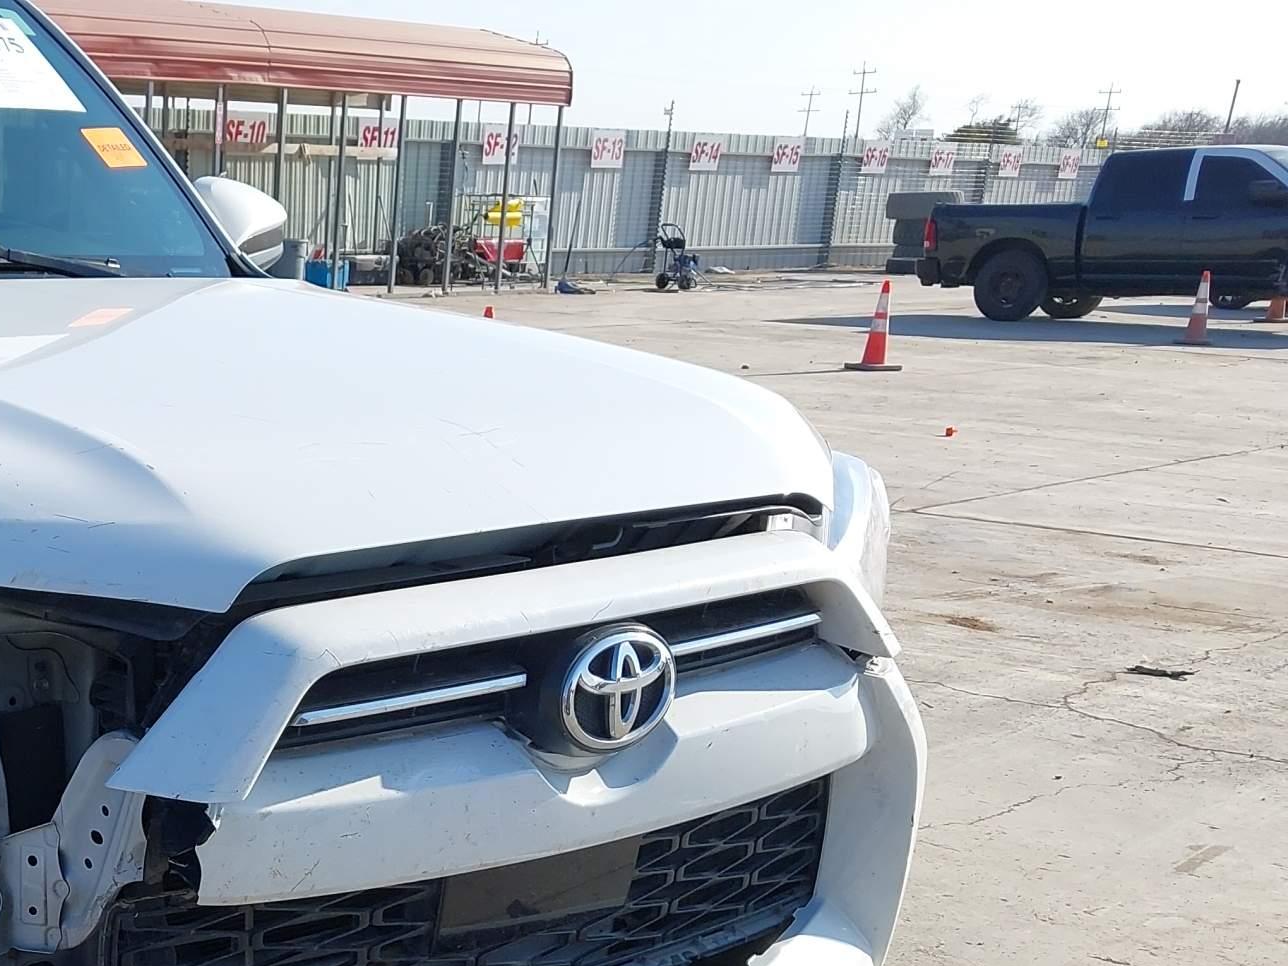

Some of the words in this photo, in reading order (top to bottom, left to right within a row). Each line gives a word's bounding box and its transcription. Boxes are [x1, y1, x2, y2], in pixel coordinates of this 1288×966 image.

[484, 132, 519, 157] SF-2
[592, 136, 624, 161] SF-13
[691, 141, 721, 164] SF-14
[772, 143, 801, 166] SF-15
[862, 146, 889, 168] SF-16
[931, 149, 955, 169] SF-17
